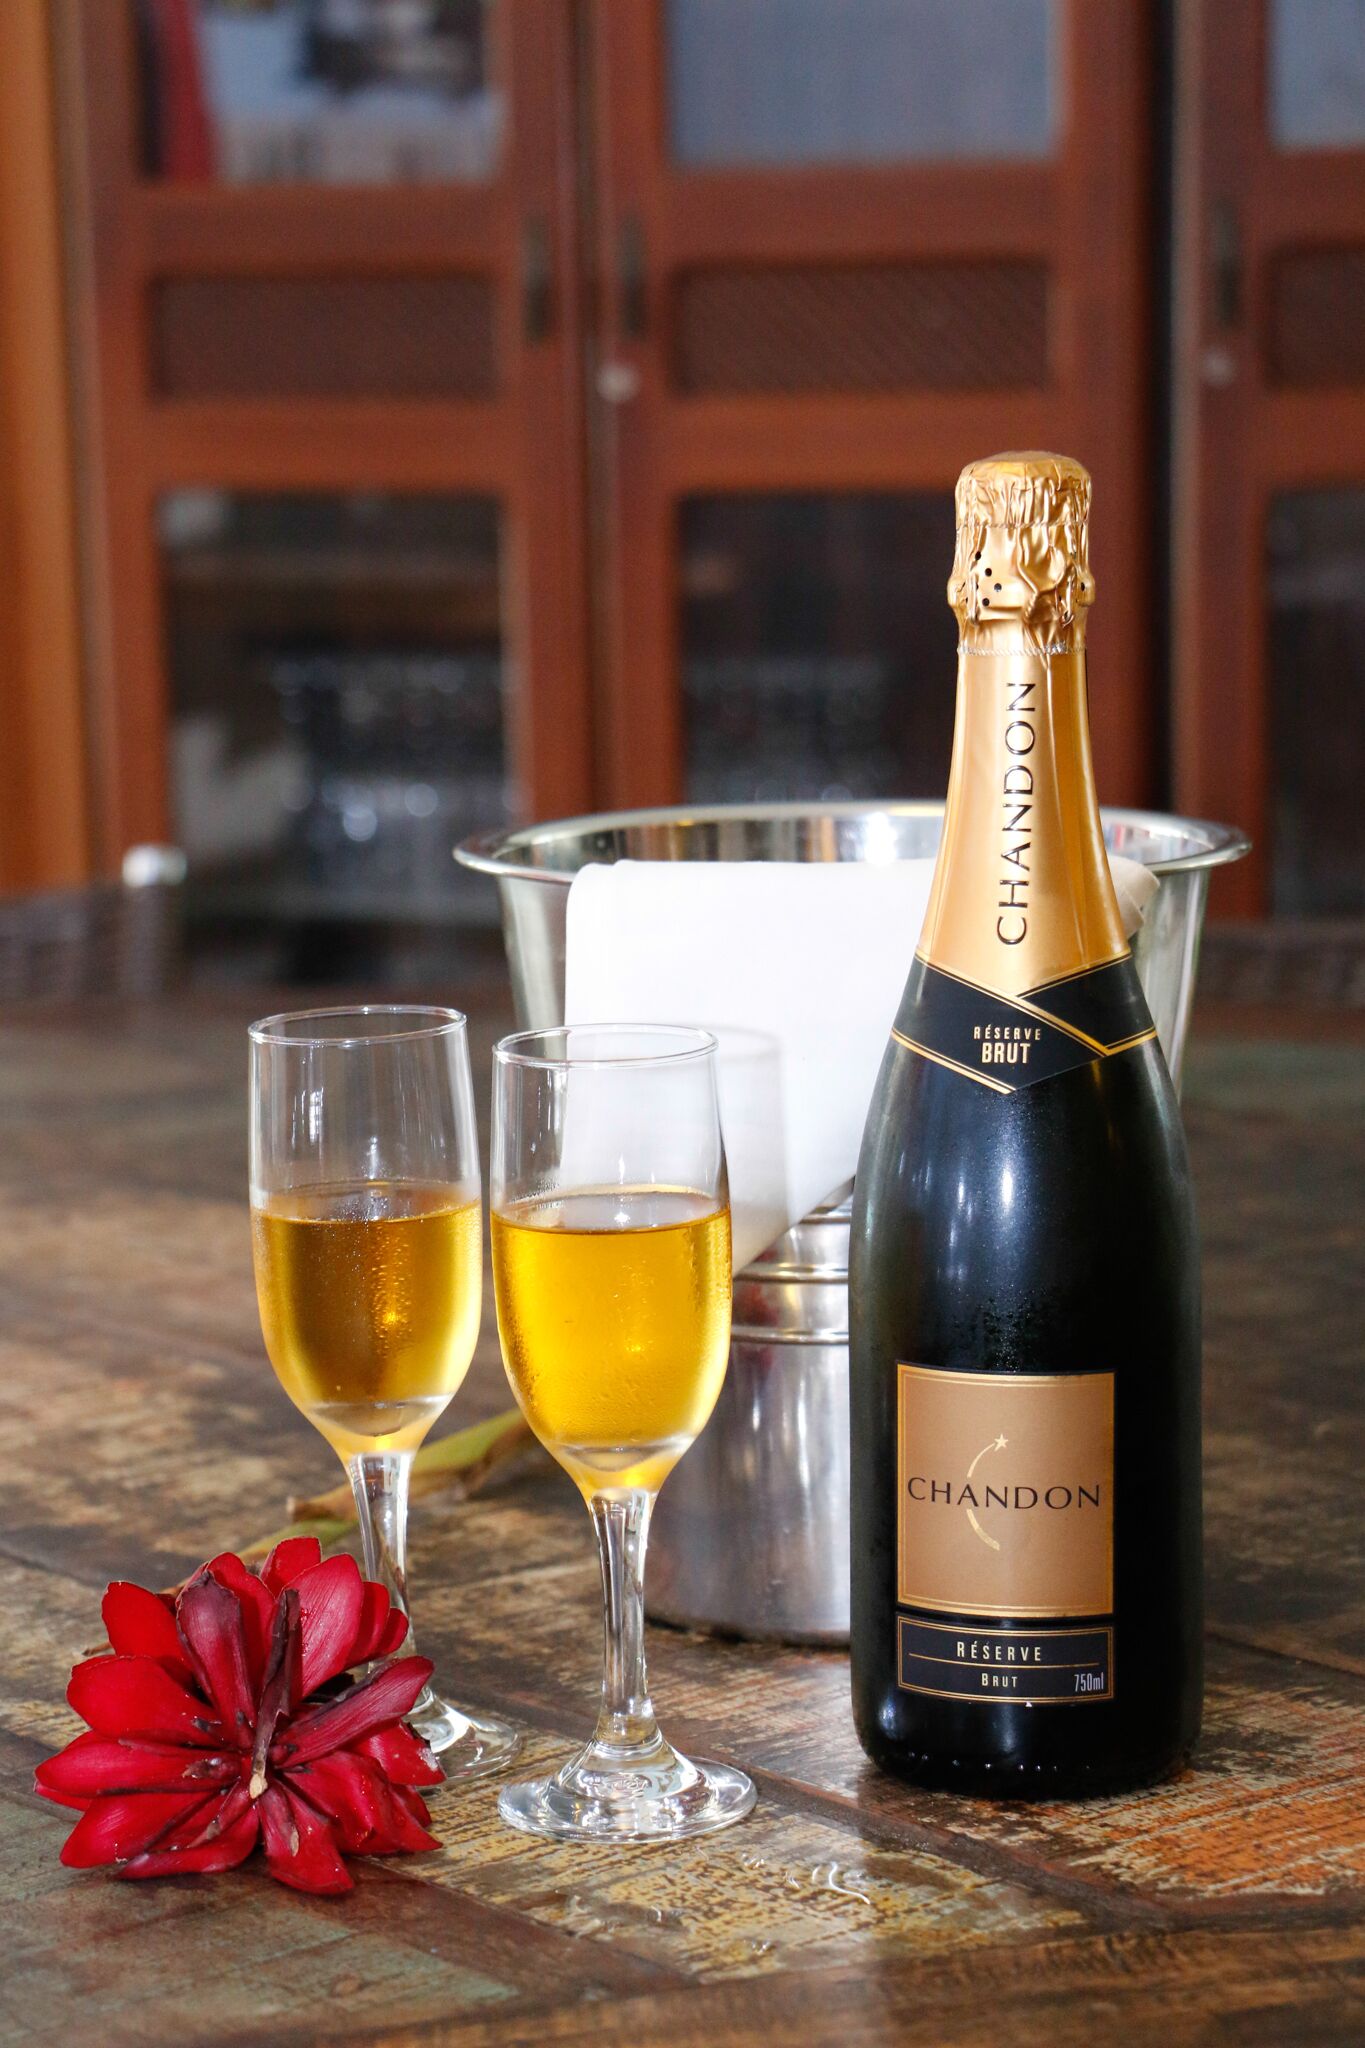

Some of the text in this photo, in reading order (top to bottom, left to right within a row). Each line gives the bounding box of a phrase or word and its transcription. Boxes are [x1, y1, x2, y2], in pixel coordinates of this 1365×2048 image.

[996, 682, 1036, 945] CHANDON
[973, 1024, 1041, 1041] RÉSERVE
[981, 1042, 1031, 1064] BRUT
[907, 1476, 1100, 1510] CHANDON
[956, 1640, 1042, 1662] RÉSERVE
[1073, 1672, 1104, 1692] 750ml
